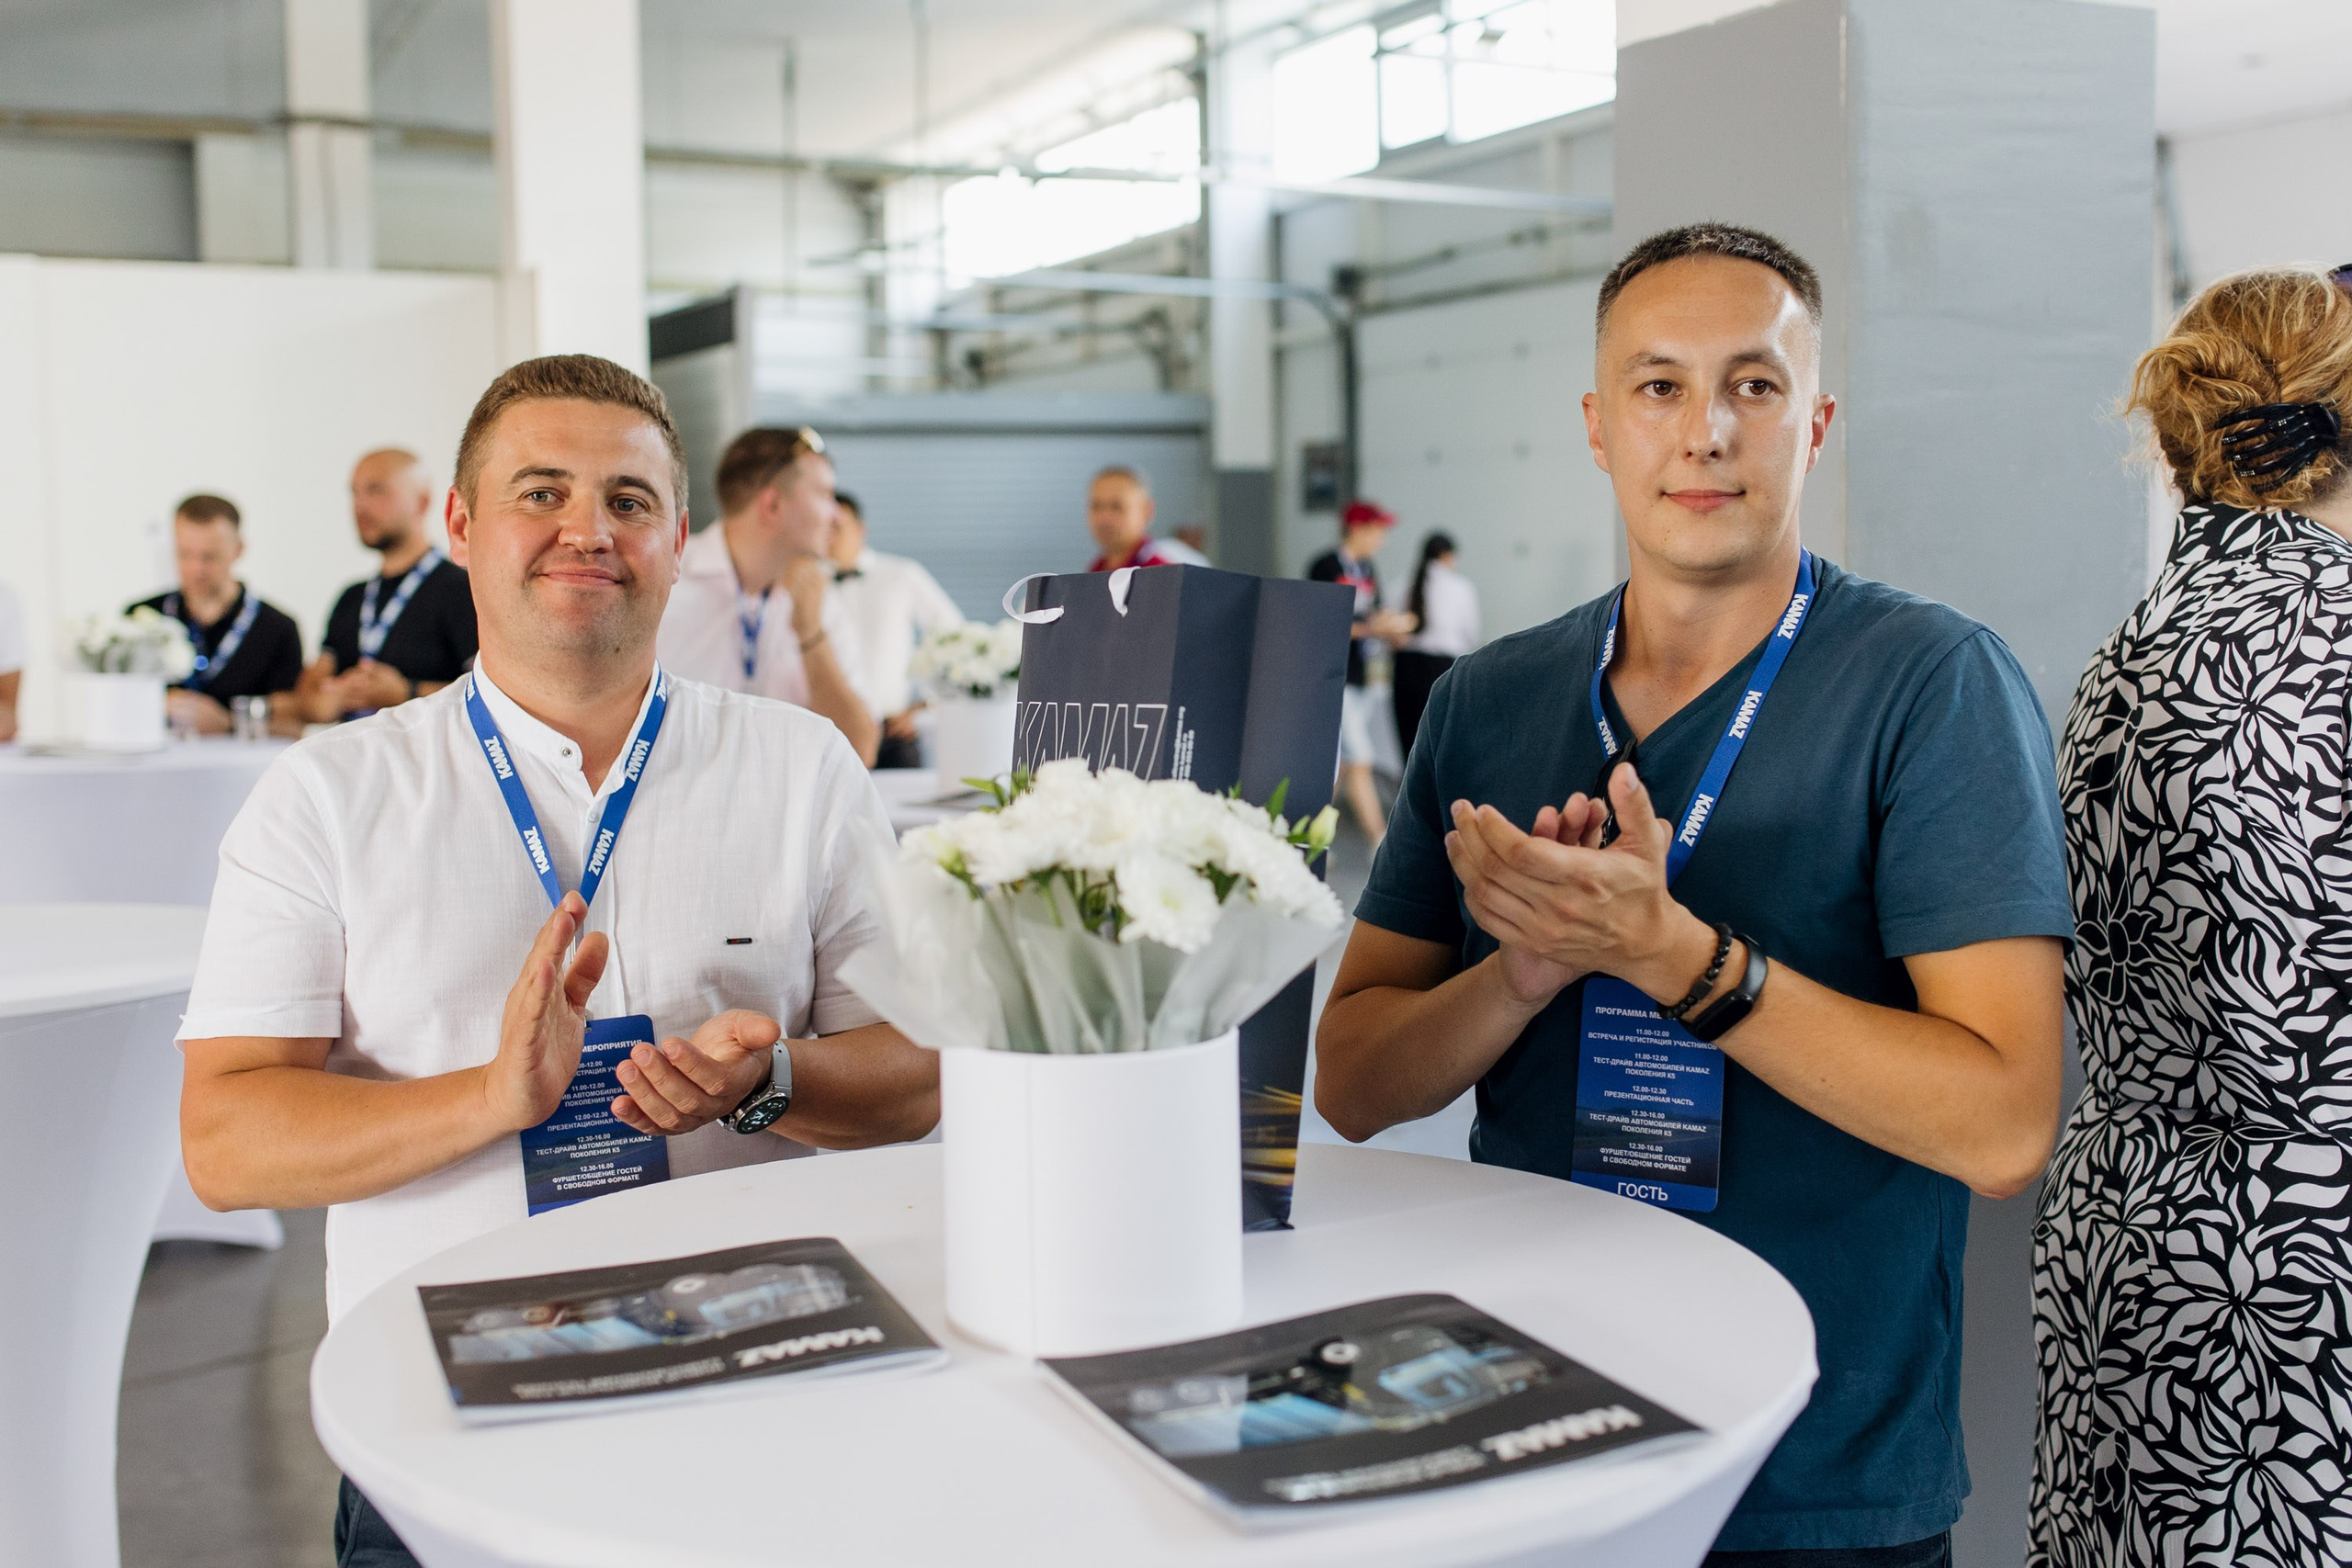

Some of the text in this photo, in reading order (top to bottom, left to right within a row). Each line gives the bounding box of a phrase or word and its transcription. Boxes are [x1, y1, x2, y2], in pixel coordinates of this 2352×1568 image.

[1777, 593, 1809, 639] KAMAZ
[1728, 690, 1762, 739] KAMAZ
[1599, 716, 1618, 759] AMAZ
[484, 736, 513, 780] KAMAZ
[625, 739, 650, 782] KAMAZ
[1679, 793, 1713, 847] KAMAZ
[524, 826, 550, 874] KAMAZ
[588, 828, 615, 876] KAMAZ
[1595, 1006, 1647, 1019] ПРОГРАММА
[1588, 1032, 1618, 1041] ВСТРЕЧА
[1625, 1035, 1672, 1046] РЕГИСТРАЦИЯ
[1635, 1029, 1669, 1037] 11.00-12.00
[1634, 1053, 1668, 1062] 11.00-12.00
[576, 1066, 606, 1077] СТРАЦИЯ
[1634, 1061, 1685, 1072] АВТОМОБИЛЕЙ
[1625, 1068, 1666, 1078] ПОКОЛЕНИЯ
[572, 1087, 623, 1100] АВТОМОБИЛЕЙ
[1632, 1085, 1667, 1094] 12.00-12.30
[565, 1098, 605, 1107] ПОКОЛЕНИЯ
[1671, 1098, 1694, 1106] ЧАСТЬ
[1622, 1125, 1662, 1135] ПОКОЛЕНИЯ
[1631, 1118, 1681, 1130] АВТОМОБИЛЕЙ
[578, 1138, 628, 1150] АВТОМОБИЛЕЙ
[629, 1135, 652, 1144] KAMAZ
[571, 1148, 611, 1159] ПОКОЛЕНИЯ
[1664, 1155, 1690, 1164] ГОСТЕЙ
[580, 1162, 614, 1172] 12.30-16.00
[616, 1165, 642, 1175] ГОСТЕЙ
[1654, 1163, 1687, 1172] ФОРМАТЕ
[563, 1179, 606, 1190] СВОБОДНОМ
[607, 1174, 639, 1184] ФОРМАТЕ
[1618, 1182, 1668, 1201] ГОСТЬ
